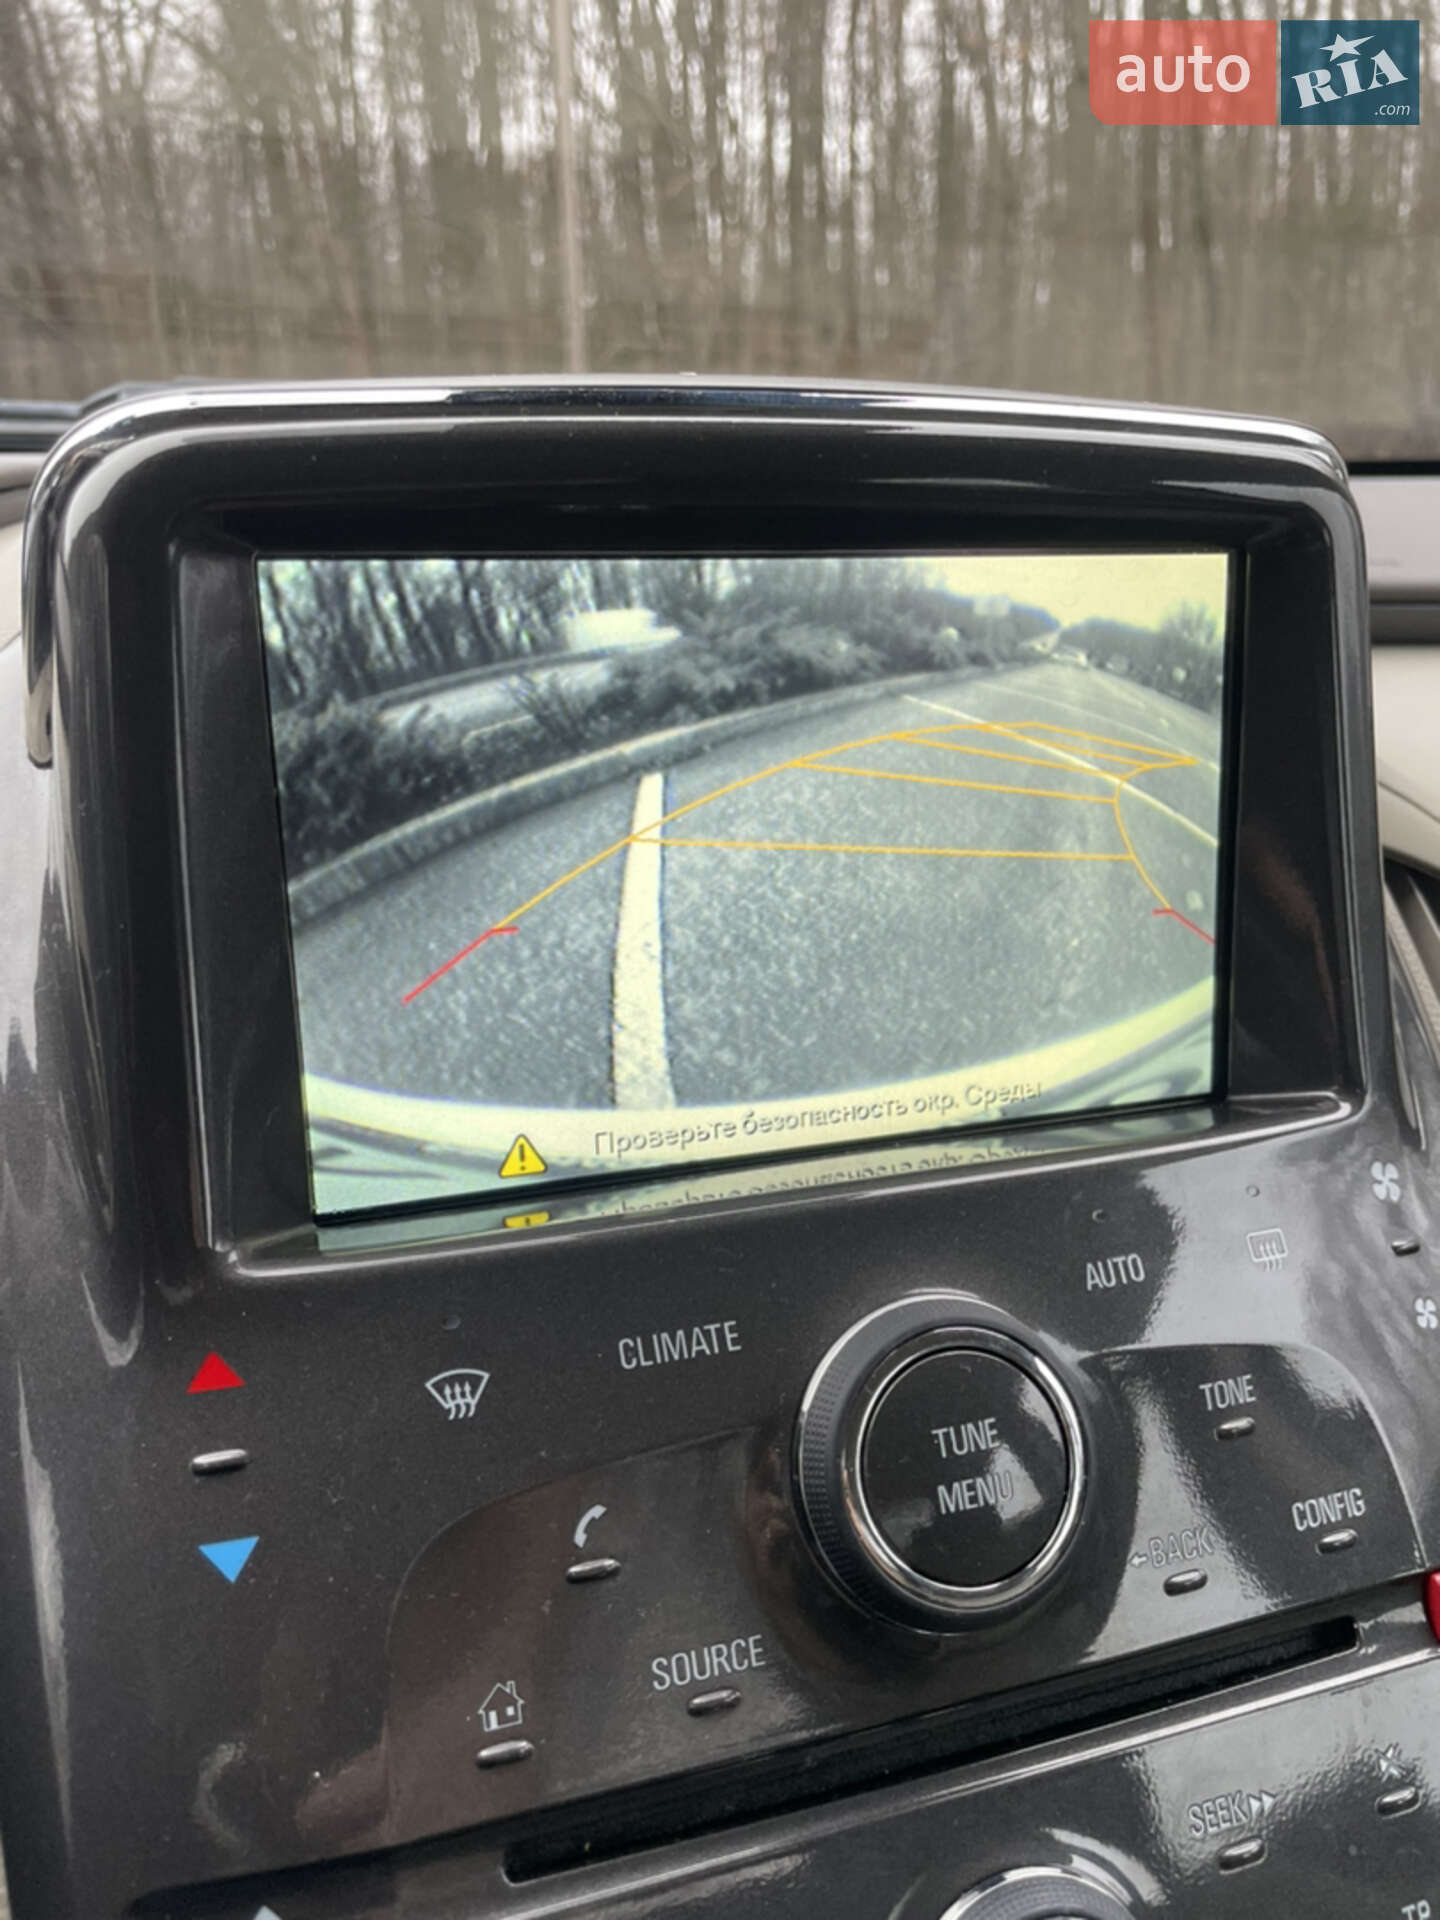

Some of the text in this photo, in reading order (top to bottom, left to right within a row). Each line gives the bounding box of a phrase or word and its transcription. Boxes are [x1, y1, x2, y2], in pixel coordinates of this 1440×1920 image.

[594, 1082, 1042, 1161] Проверьте безопасность окр. Среды
[1085, 1253, 1146, 1292] AUTO
[617, 1320, 742, 1371] CLIMATE
[1199, 1374, 1257, 1411] TONE
[931, 1417, 1001, 1459] TUNE
[936, 1470, 1016, 1516] MENU
[1290, 1487, 1366, 1533] CONFIG
[1149, 1527, 1214, 1569] BACK
[650, 1634, 766, 1692] SOURCE
[1188, 1790, 1249, 1838] SEEK
